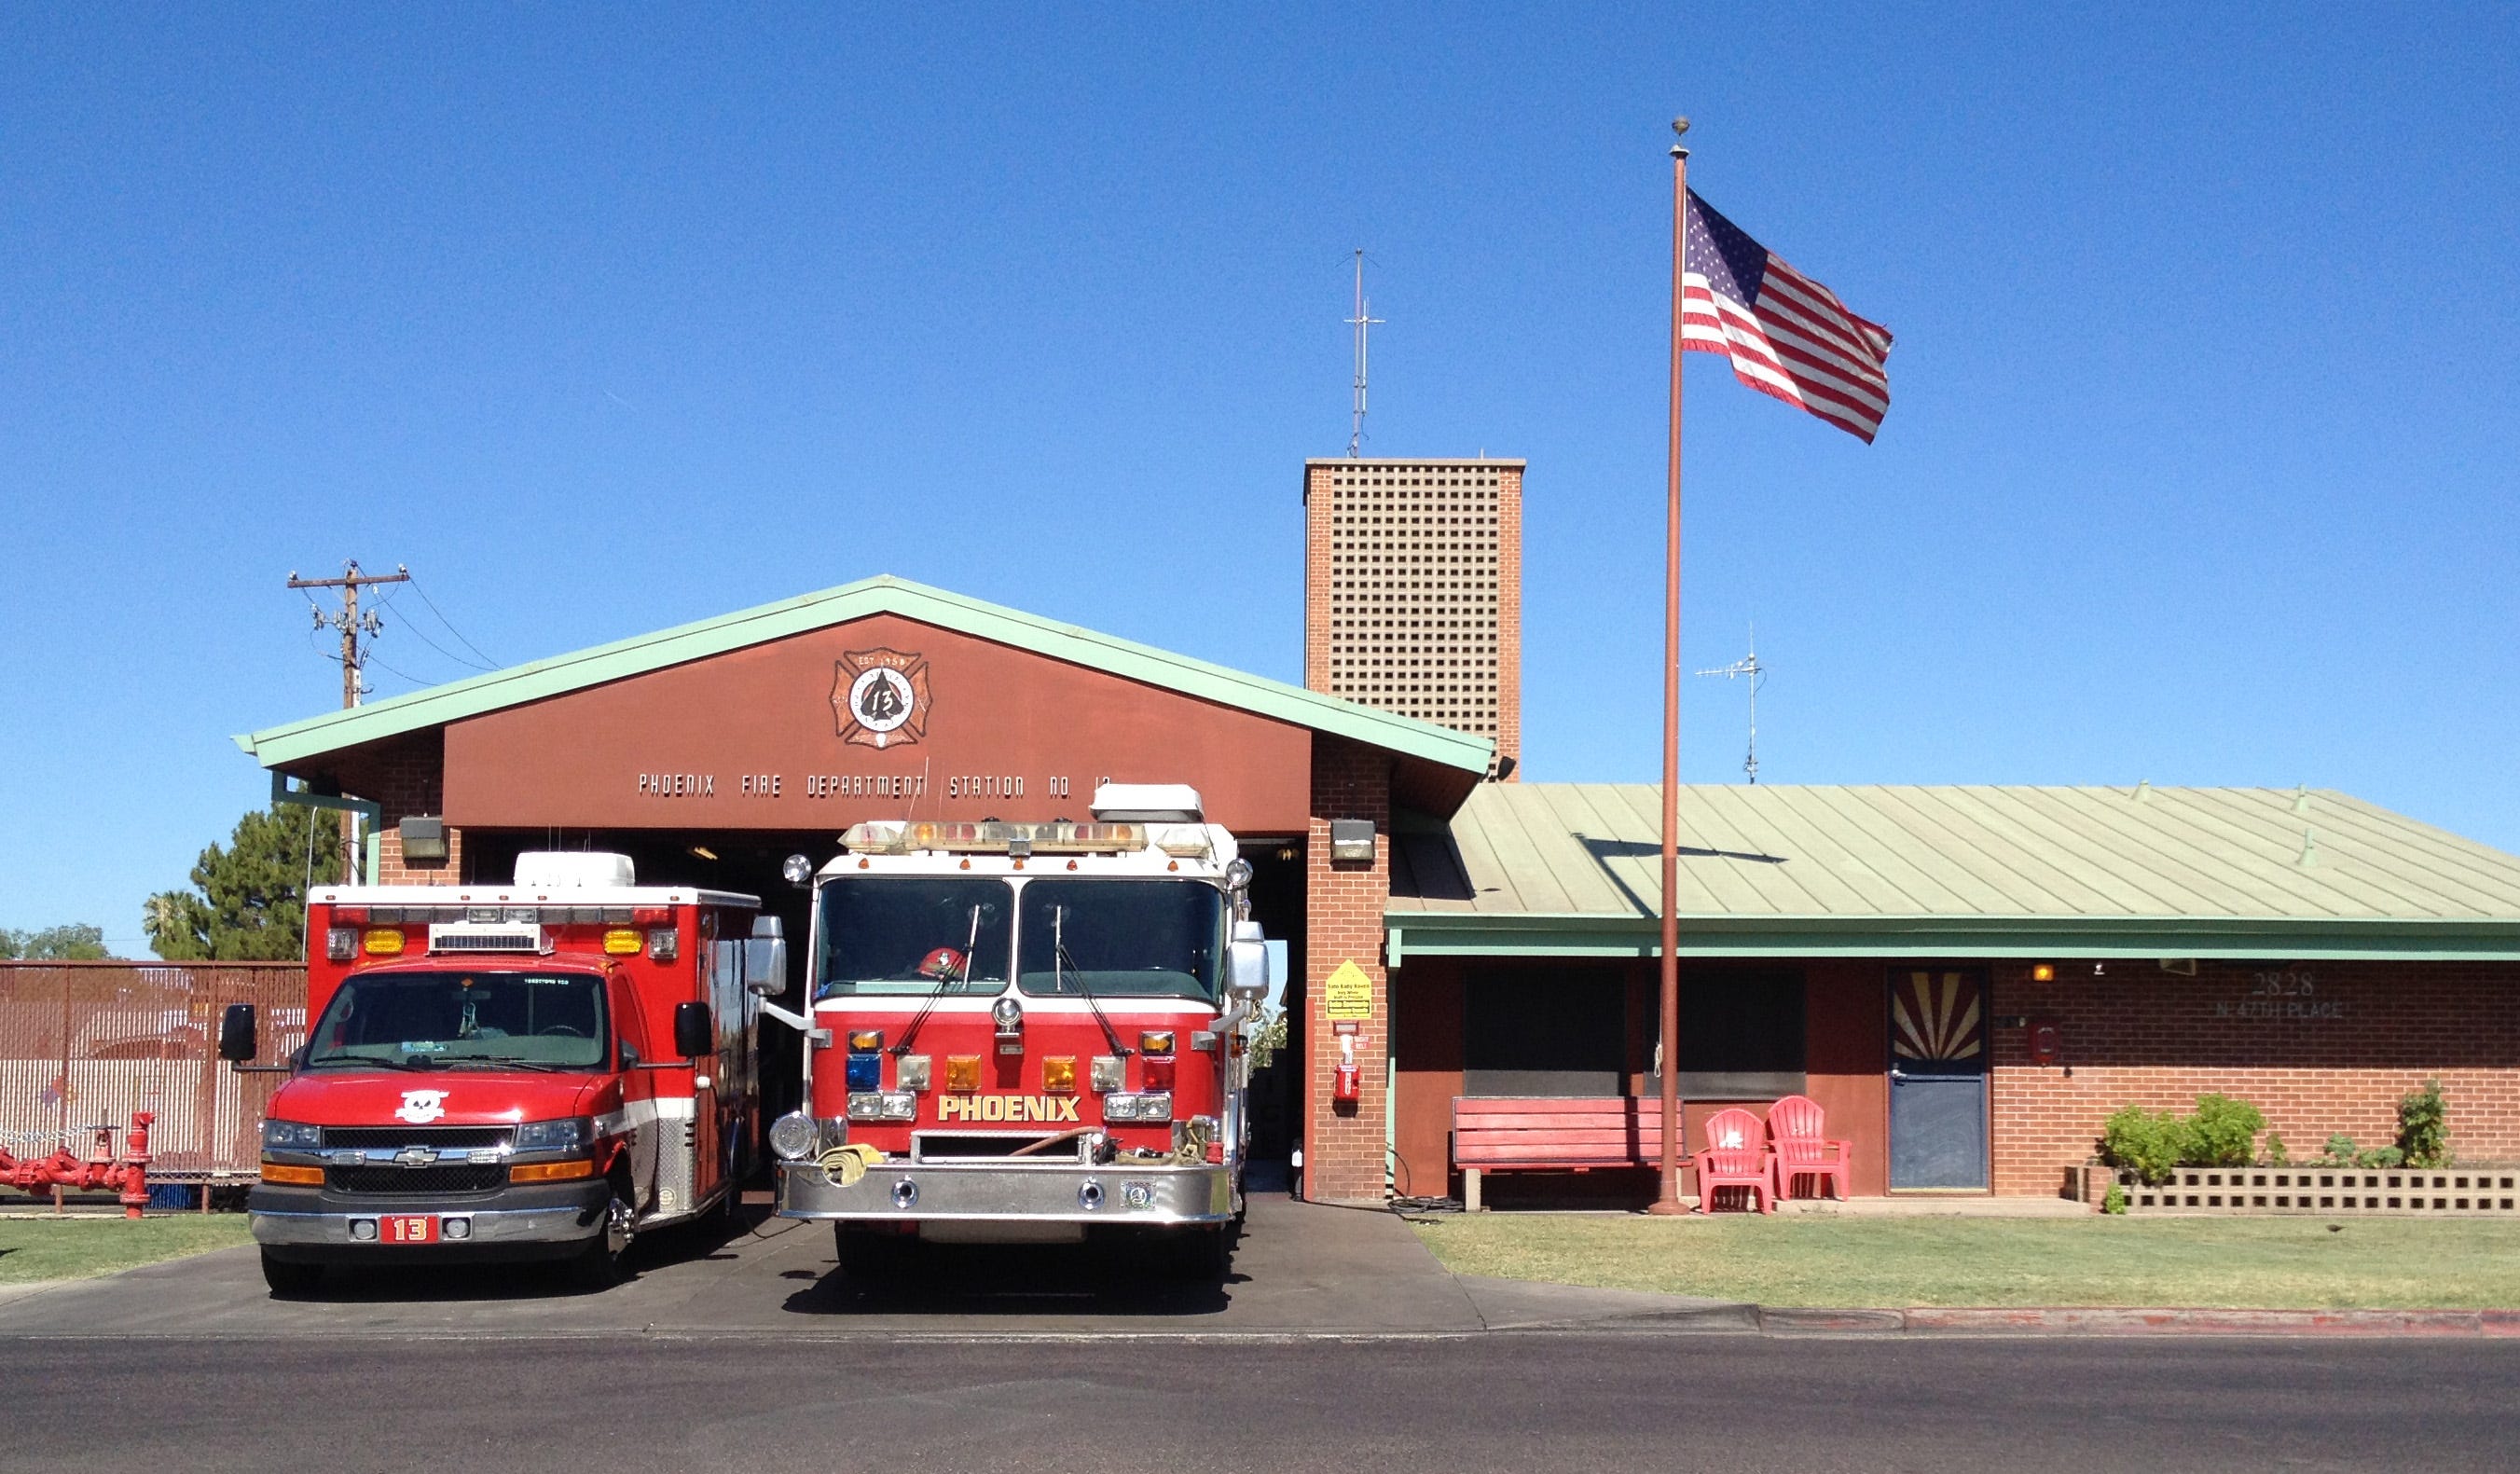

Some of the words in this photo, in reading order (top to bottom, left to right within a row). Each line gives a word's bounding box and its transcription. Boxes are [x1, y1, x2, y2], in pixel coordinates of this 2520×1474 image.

[872, 690, 894, 711] 13
[639, 774, 714, 794] PHOENIX
[742, 775, 781, 795] FIRE
[807, 775, 924, 795] DEPARTMENT
[950, 777, 1024, 795] STATION
[2251, 971, 2314, 996] 2828
[2216, 1001, 2228, 1017] N
[2288, 1002, 2343, 1018] PLACE
[938, 1095, 1081, 1123] PHOENIX
[393, 1219, 427, 1241] 13
